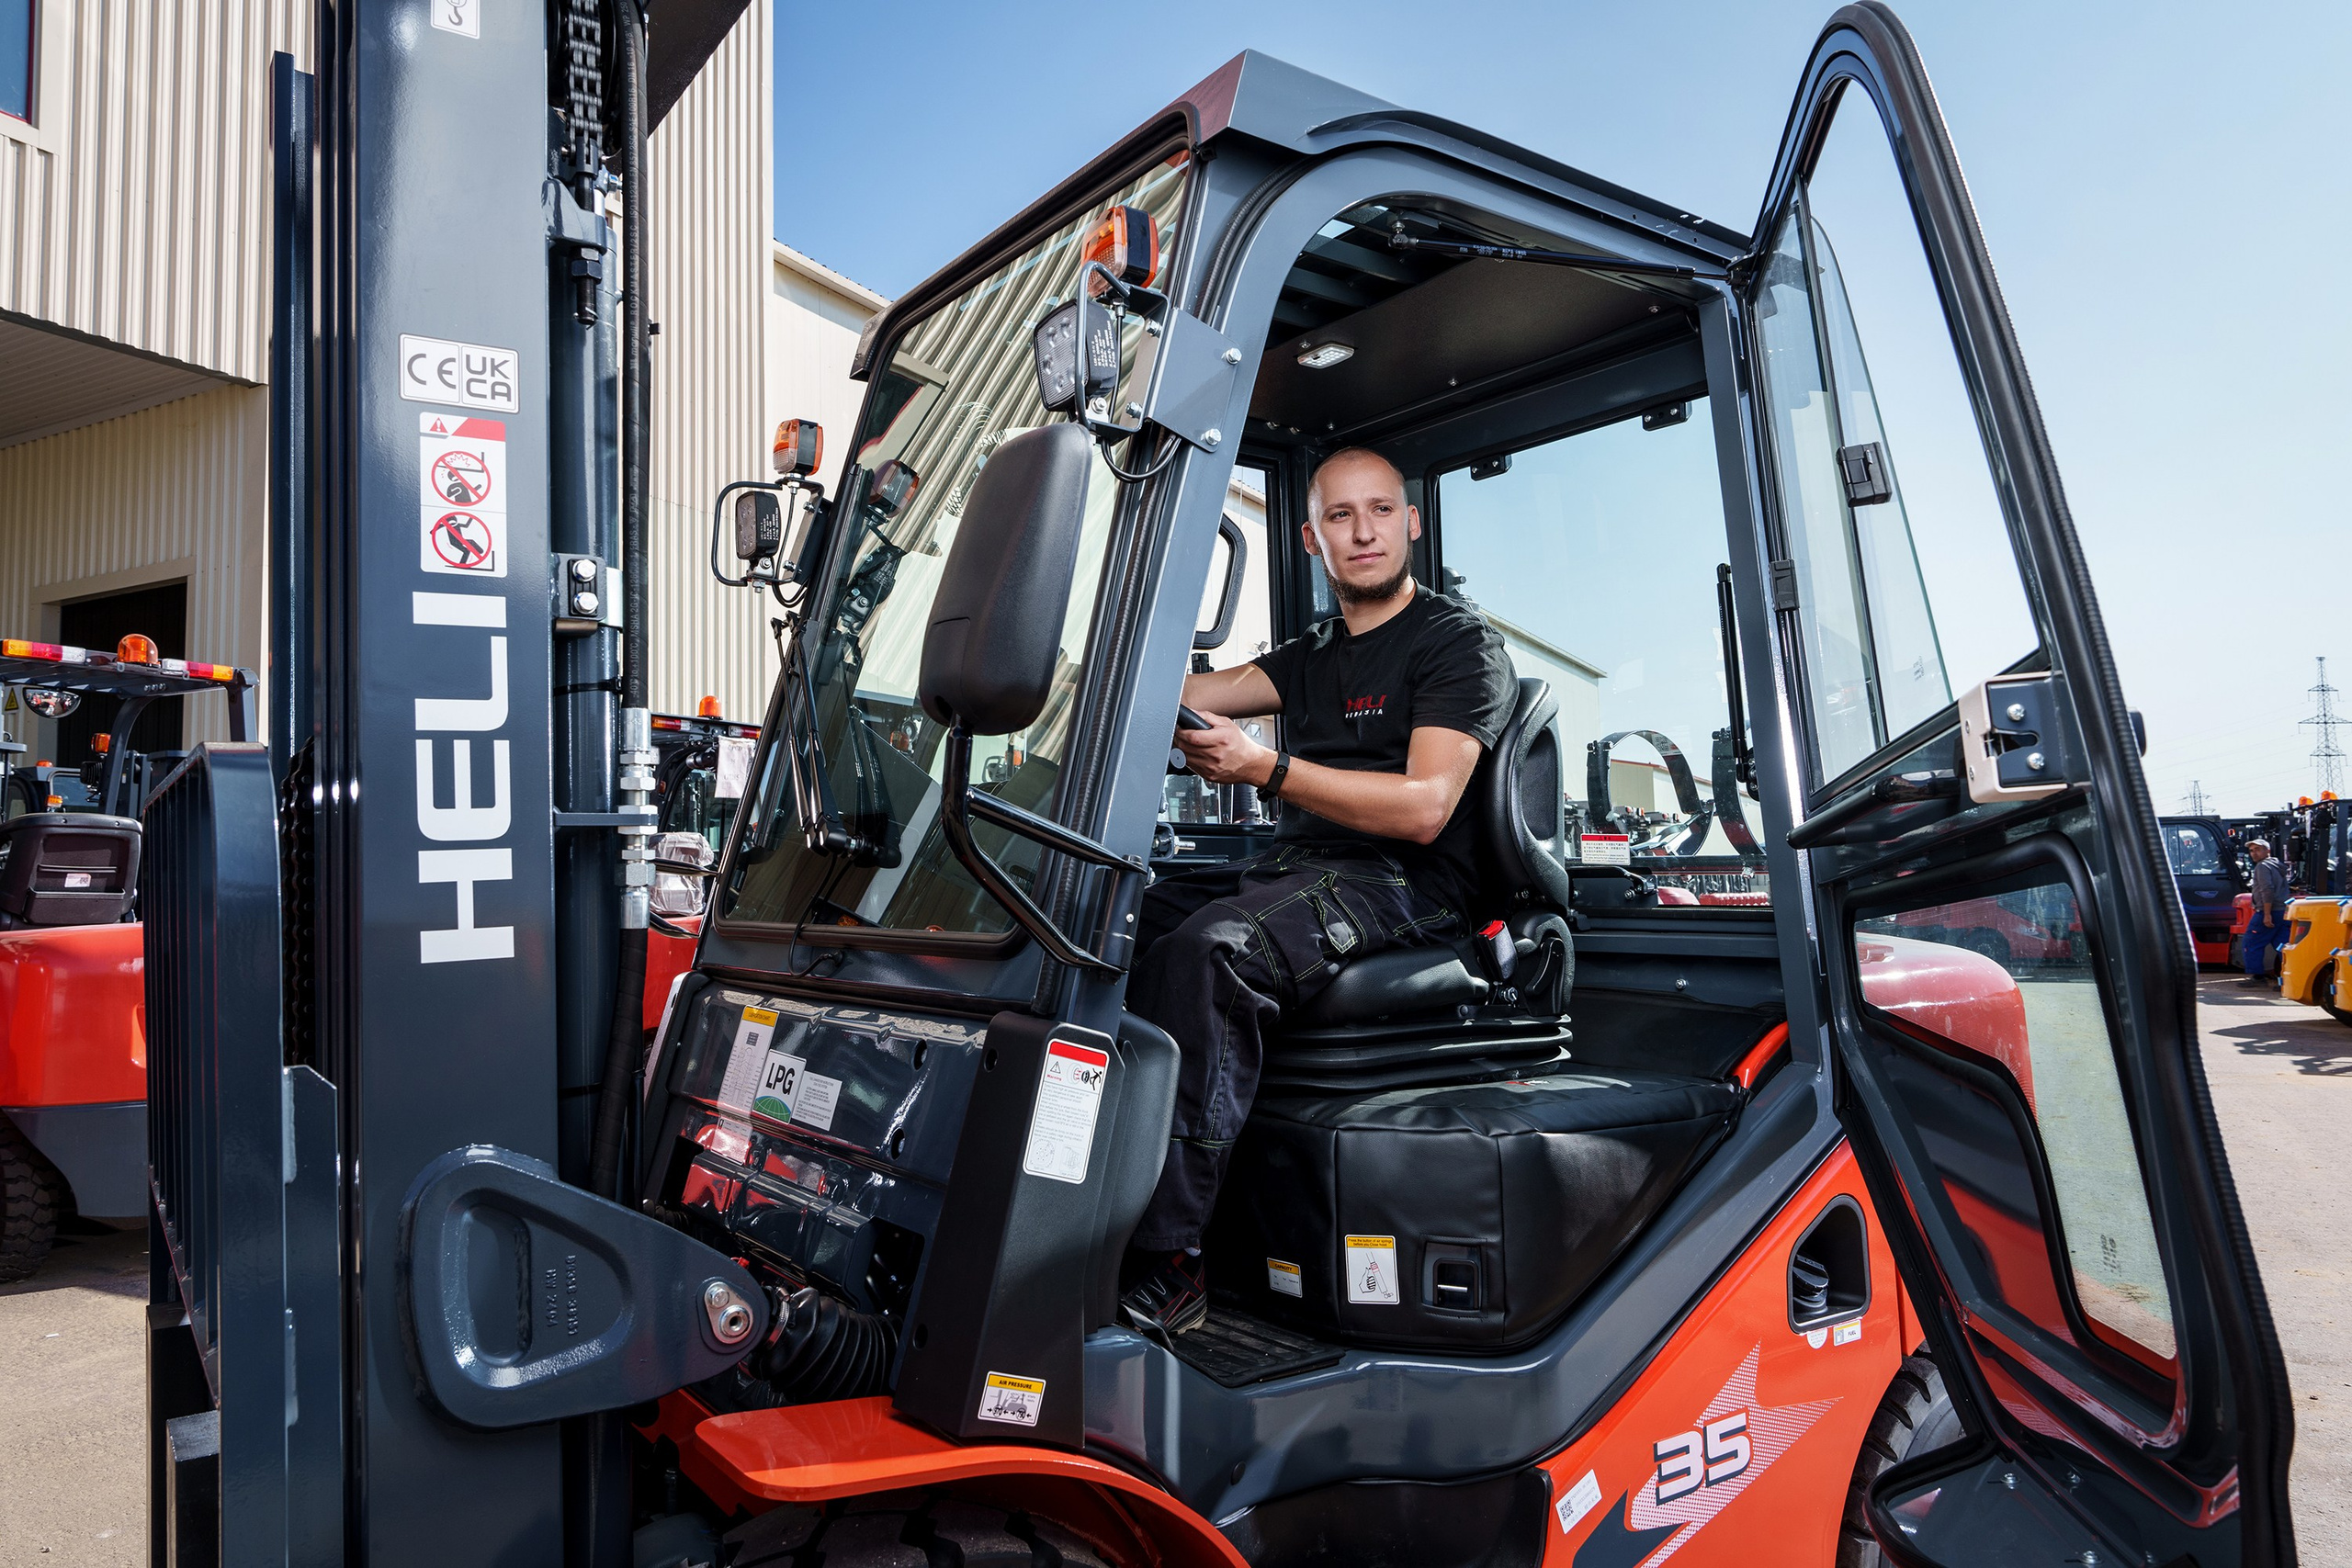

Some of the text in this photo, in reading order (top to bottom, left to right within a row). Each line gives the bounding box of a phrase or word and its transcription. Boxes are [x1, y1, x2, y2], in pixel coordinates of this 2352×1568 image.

[620, 1, 629, 12] 250
[622, 15, 630, 26] WP
[627, 62, 634, 70] 16
[628, 72, 635, 83] DN
[630, 167, 637, 177] EN
[407, 353, 456, 389] CE
[466, 354, 510, 379] UK
[466, 378, 511, 402] CA
[1346, 694, 1387, 712] HELI
[413, 591, 514, 964] HELI
[766, 1063, 795, 1095] LPG
[1655, 1412, 1751, 1506] 35
